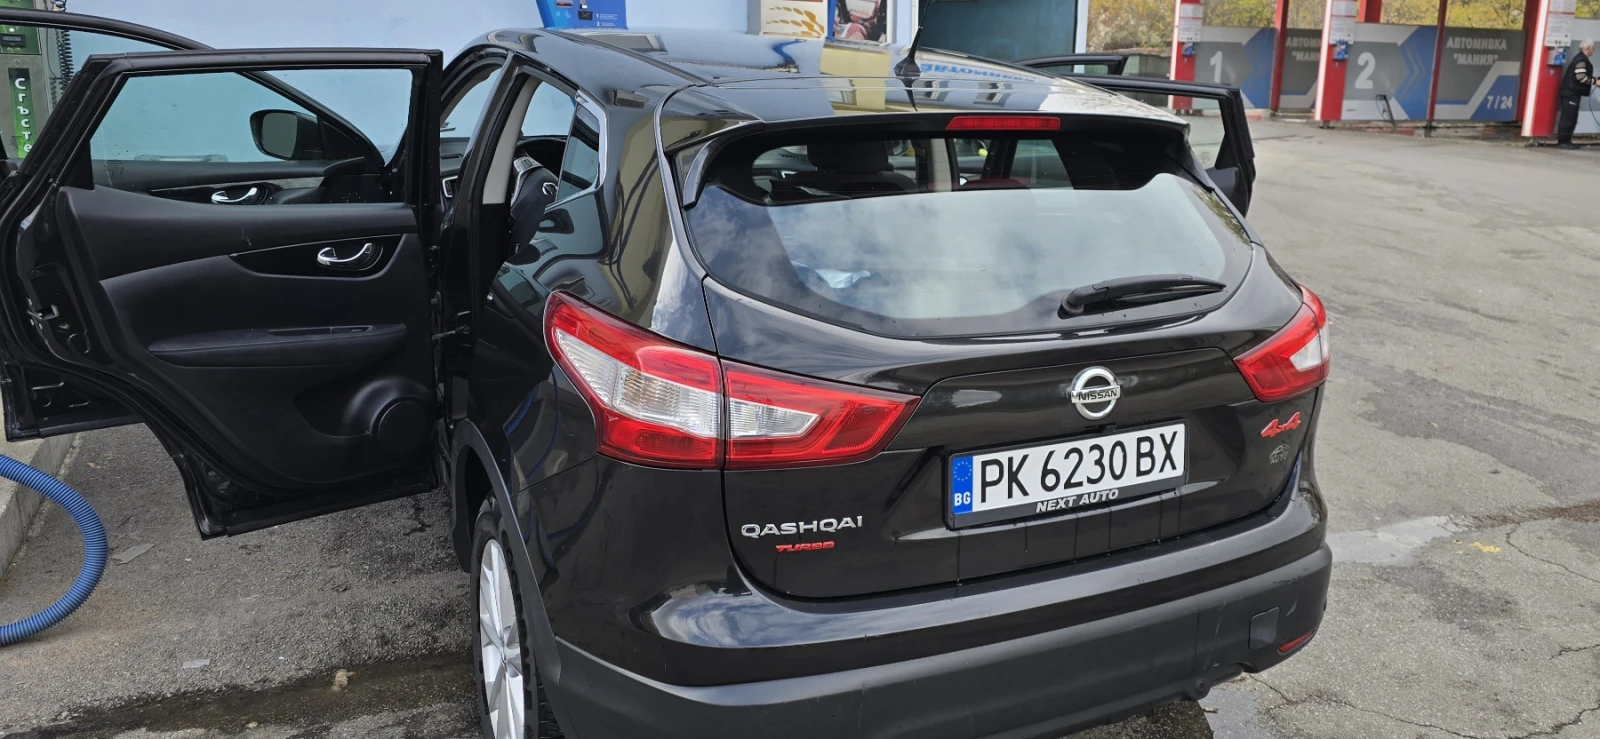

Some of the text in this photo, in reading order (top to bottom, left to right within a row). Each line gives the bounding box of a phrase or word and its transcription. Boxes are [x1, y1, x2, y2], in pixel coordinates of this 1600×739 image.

[1446, 36, 1507, 50] АВТОМИВКА
[1209, 51, 1223, 83] 1
[1354, 52, 1376, 89] 2
[14, 77, 32, 153] Сгъсте
[1078, 389, 1118, 401] NISSAN
[980, 431, 1178, 504] PK 6230 BX
[954, 491, 972, 507] BG
[1036, 488, 1119, 514] NEXT AUTO
[741, 515, 863, 539] QASHQAI
[775, 541, 835, 553] TURBO
